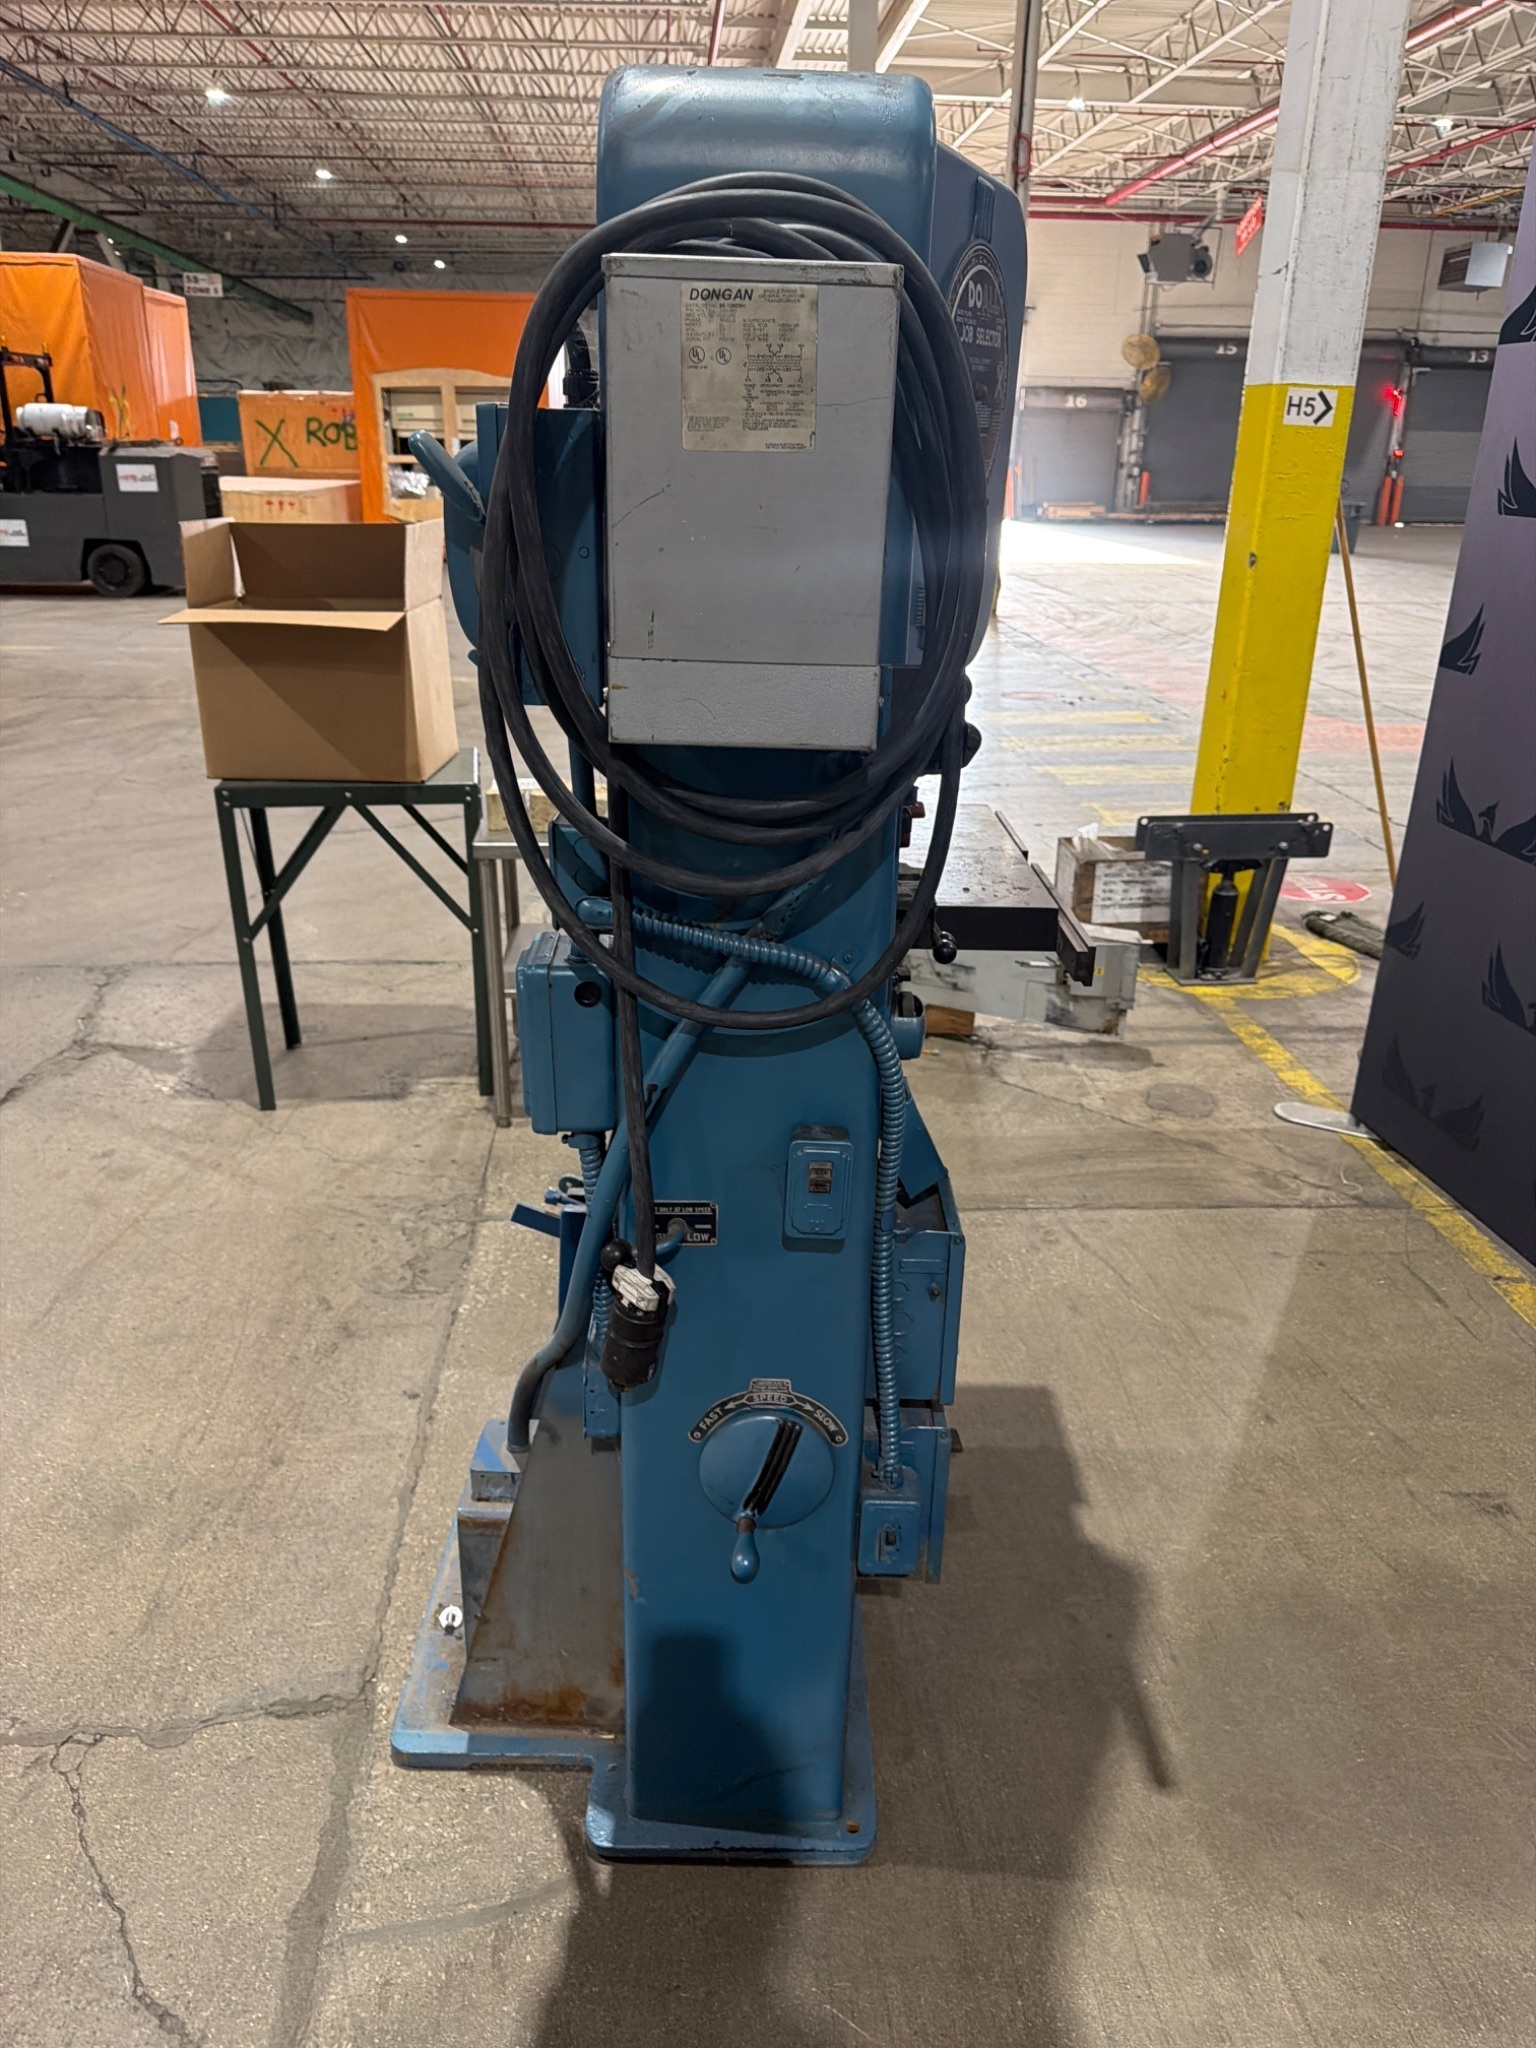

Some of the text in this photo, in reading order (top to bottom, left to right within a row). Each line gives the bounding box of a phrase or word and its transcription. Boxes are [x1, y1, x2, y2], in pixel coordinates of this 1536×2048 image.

[689, 288, 754, 301] DONGAN
[1468, 350, 1489, 363] 13
[1065, 394, 1087, 408] 16
[1286, 395, 1316, 417] H5
[687, 1232, 709, 1242] LOW
[753, 1394, 788, 1403] SPEED
[700, 1406, 725, 1430] FAST
[813, 1409, 839, 1432] SLOW
